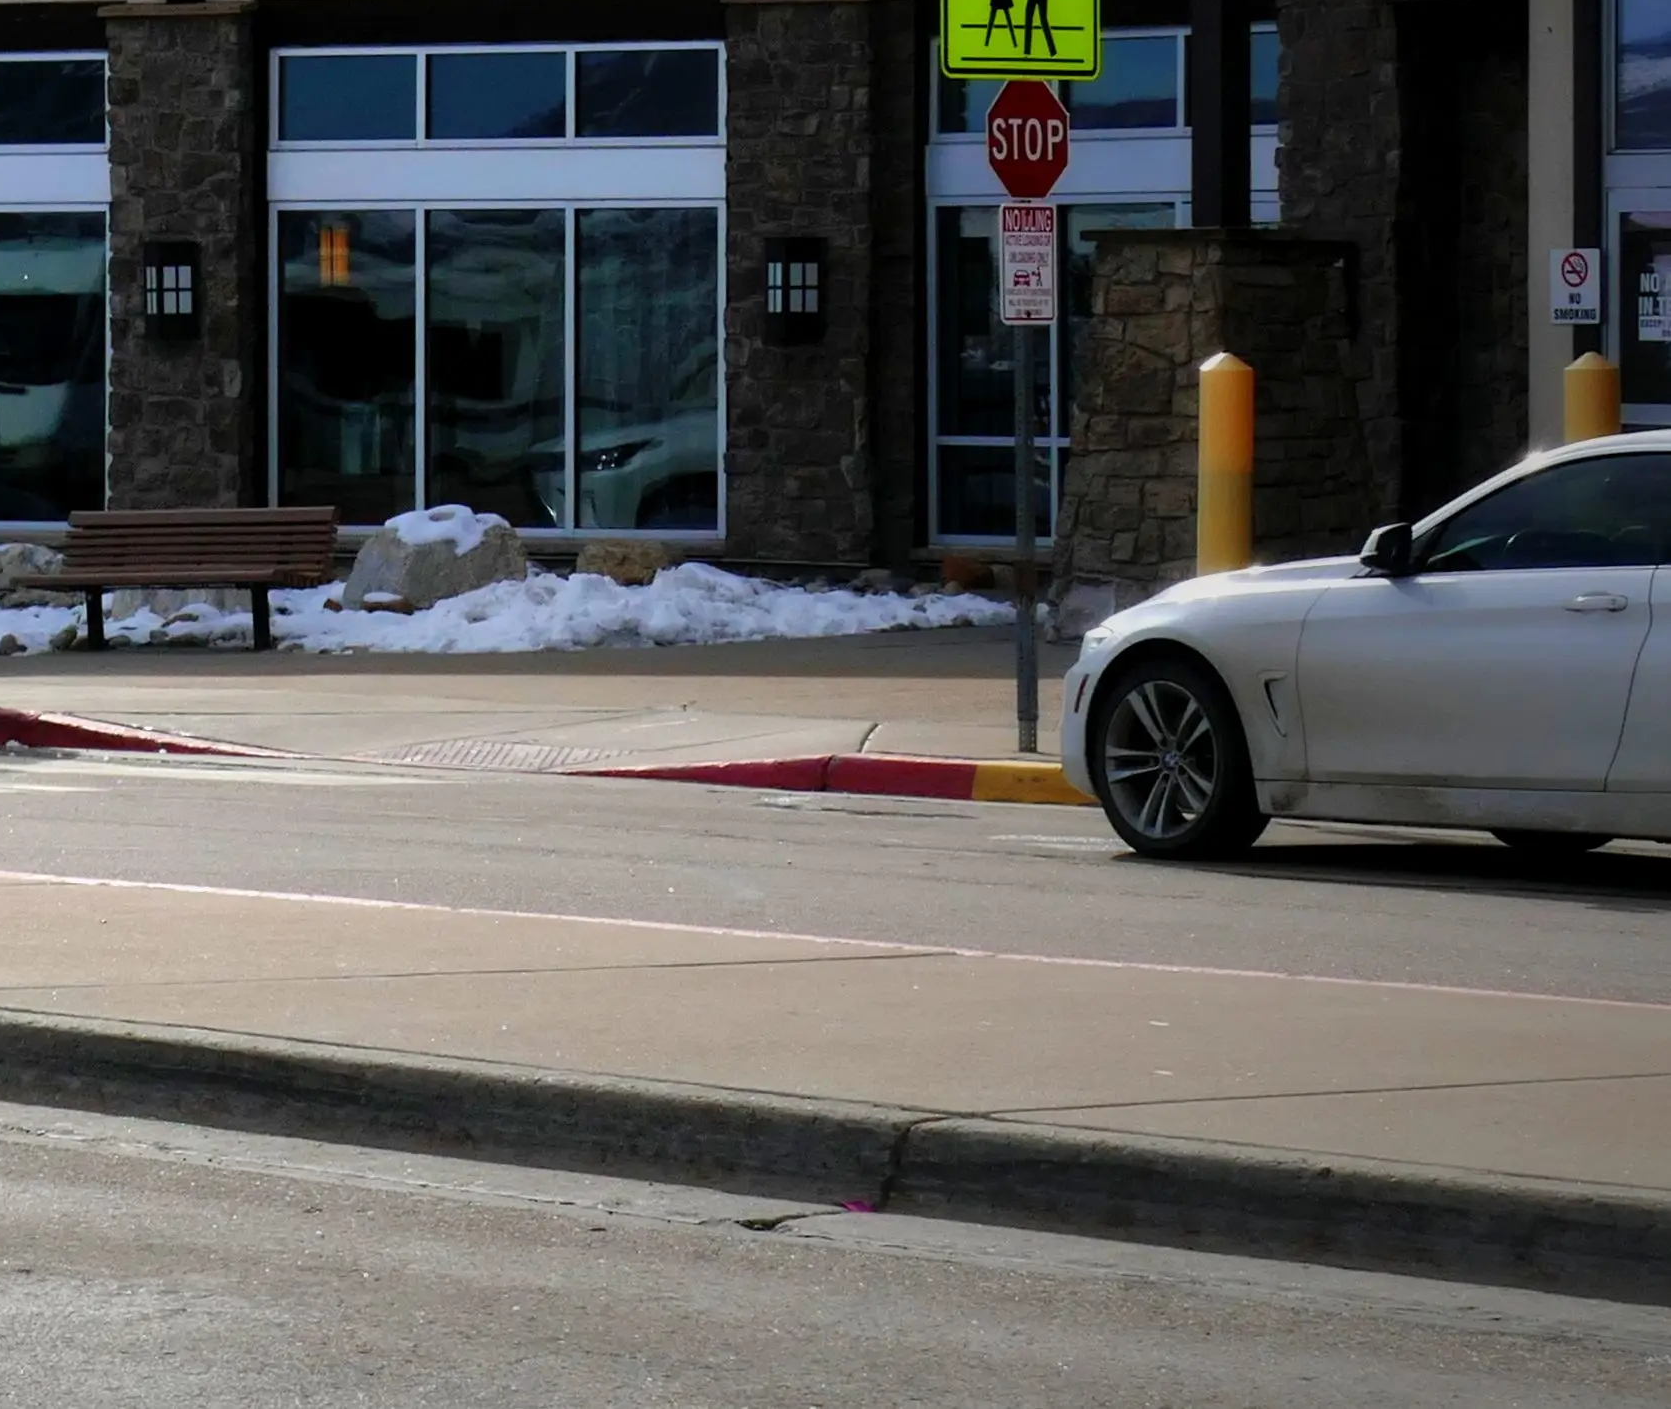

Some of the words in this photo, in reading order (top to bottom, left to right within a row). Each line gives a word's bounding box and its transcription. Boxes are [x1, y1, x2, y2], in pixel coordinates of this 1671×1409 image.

[992, 117, 1064, 161] STOP
[1005, 209, 1020, 232] NO
[1640, 273, 1660, 294] NO
[1568, 293, 1581, 304] NO
[1554, 309, 1596, 320] SMOKING
